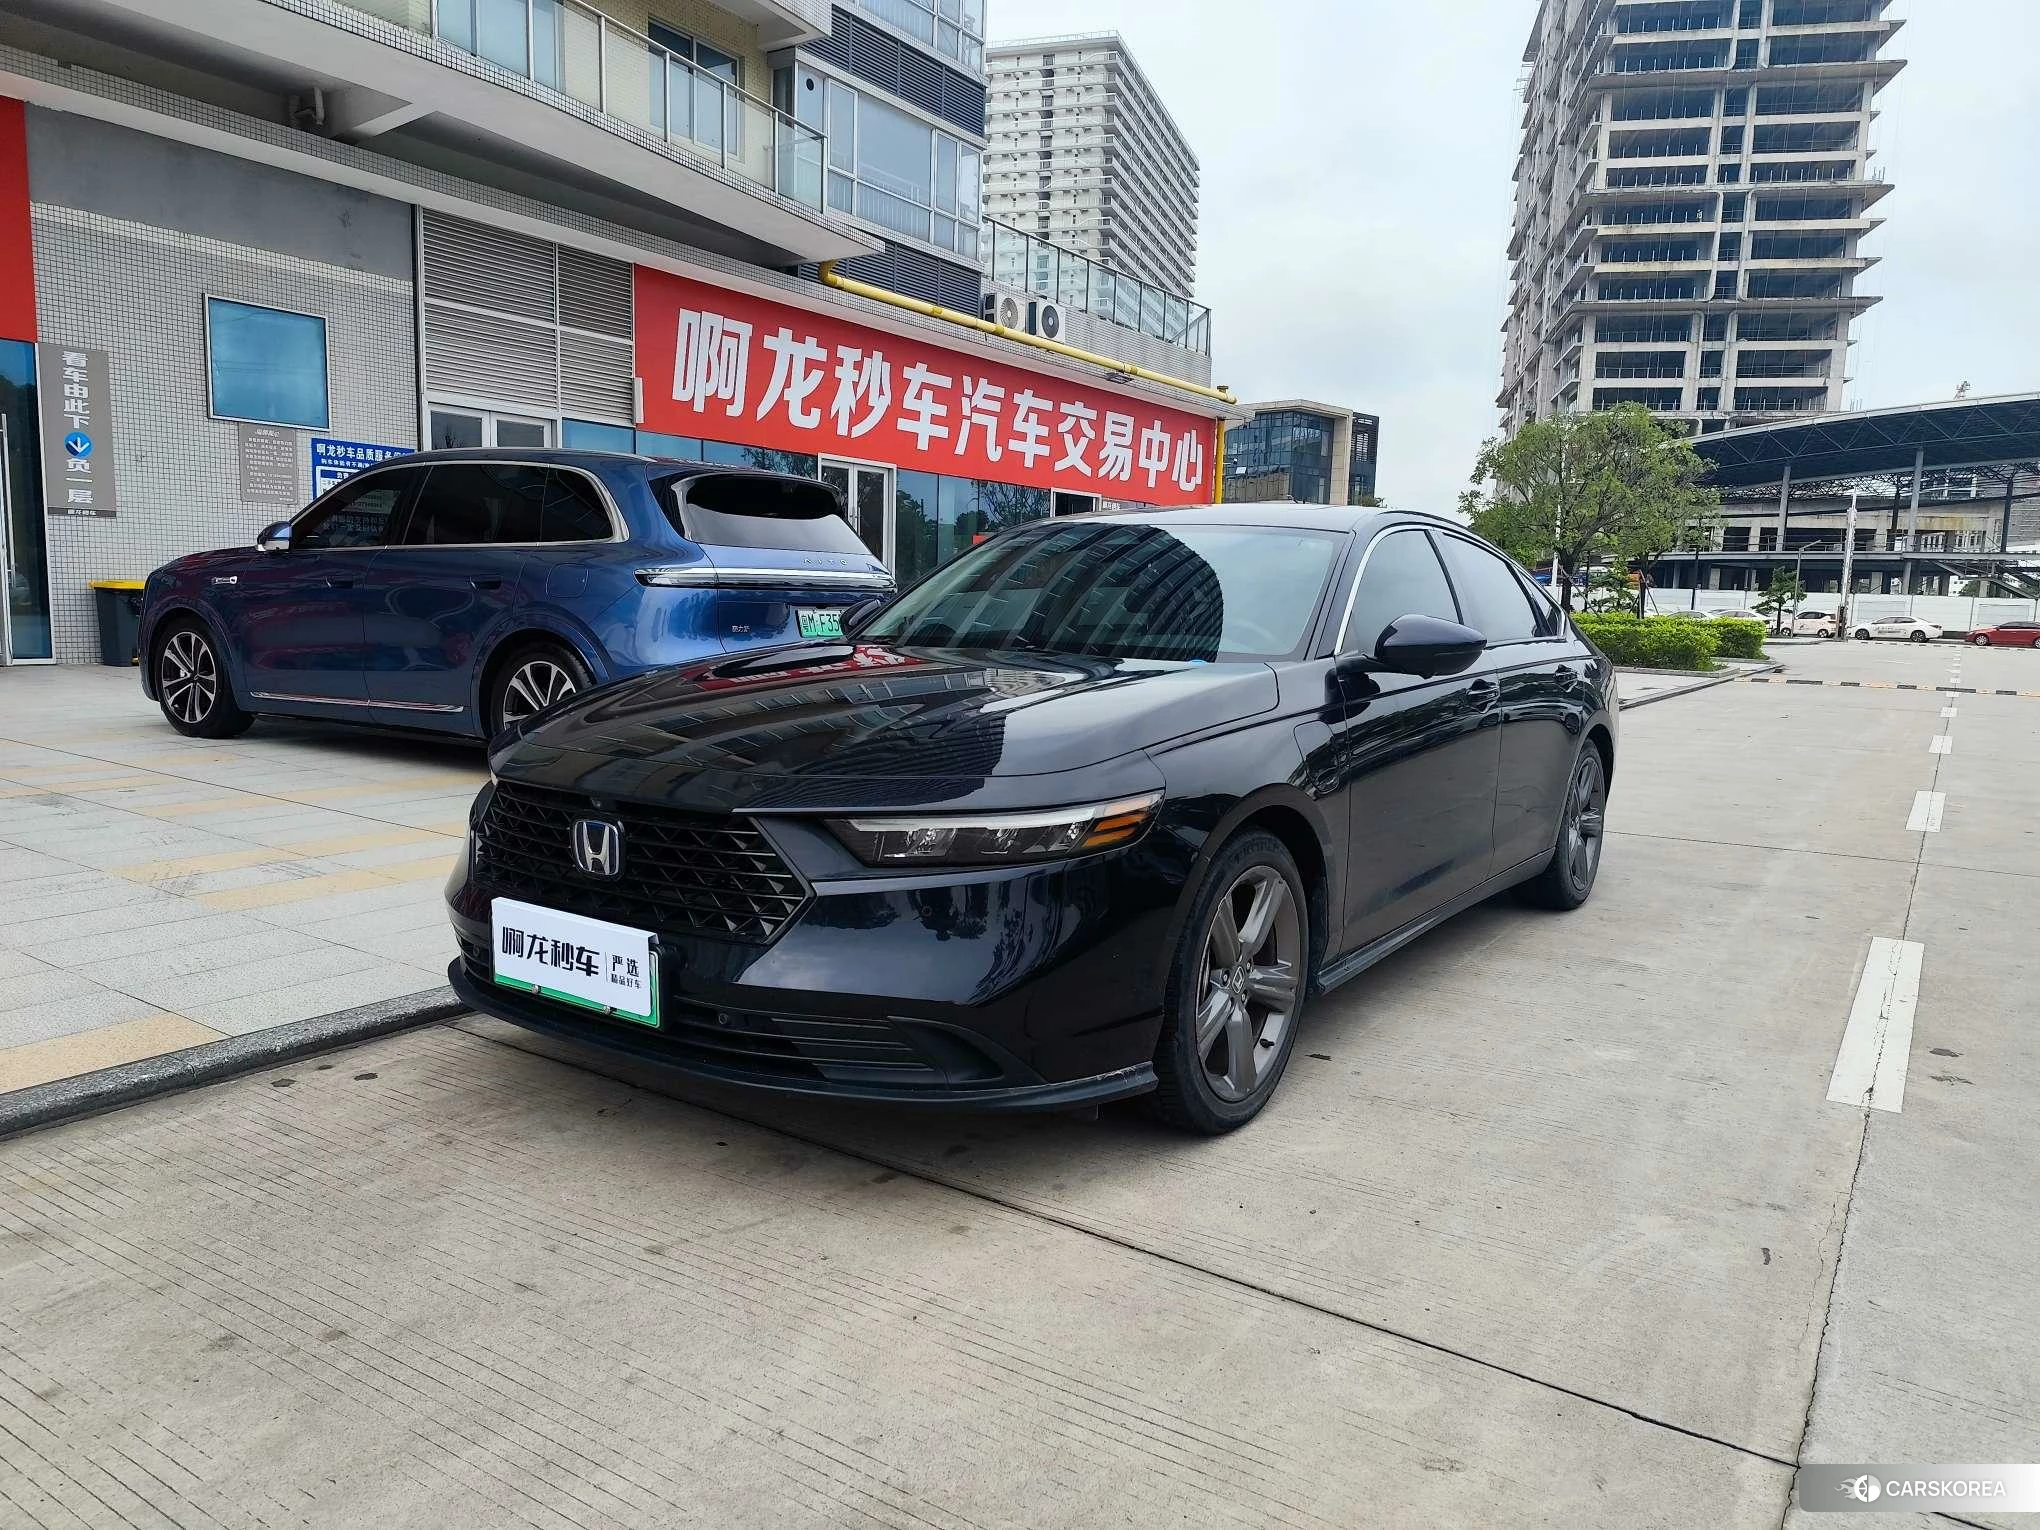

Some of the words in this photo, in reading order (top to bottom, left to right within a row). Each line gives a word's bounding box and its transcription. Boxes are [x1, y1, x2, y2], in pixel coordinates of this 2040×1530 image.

[62, 351, 90, 429] 看车由此下
[671, 308, 1203, 493] 啊龙秒车汽车交易中心
[66, 458, 94, 504] 负一层
[502, 926, 600, 977] 啊龙秒车
[611, 954, 639, 977] 严选
